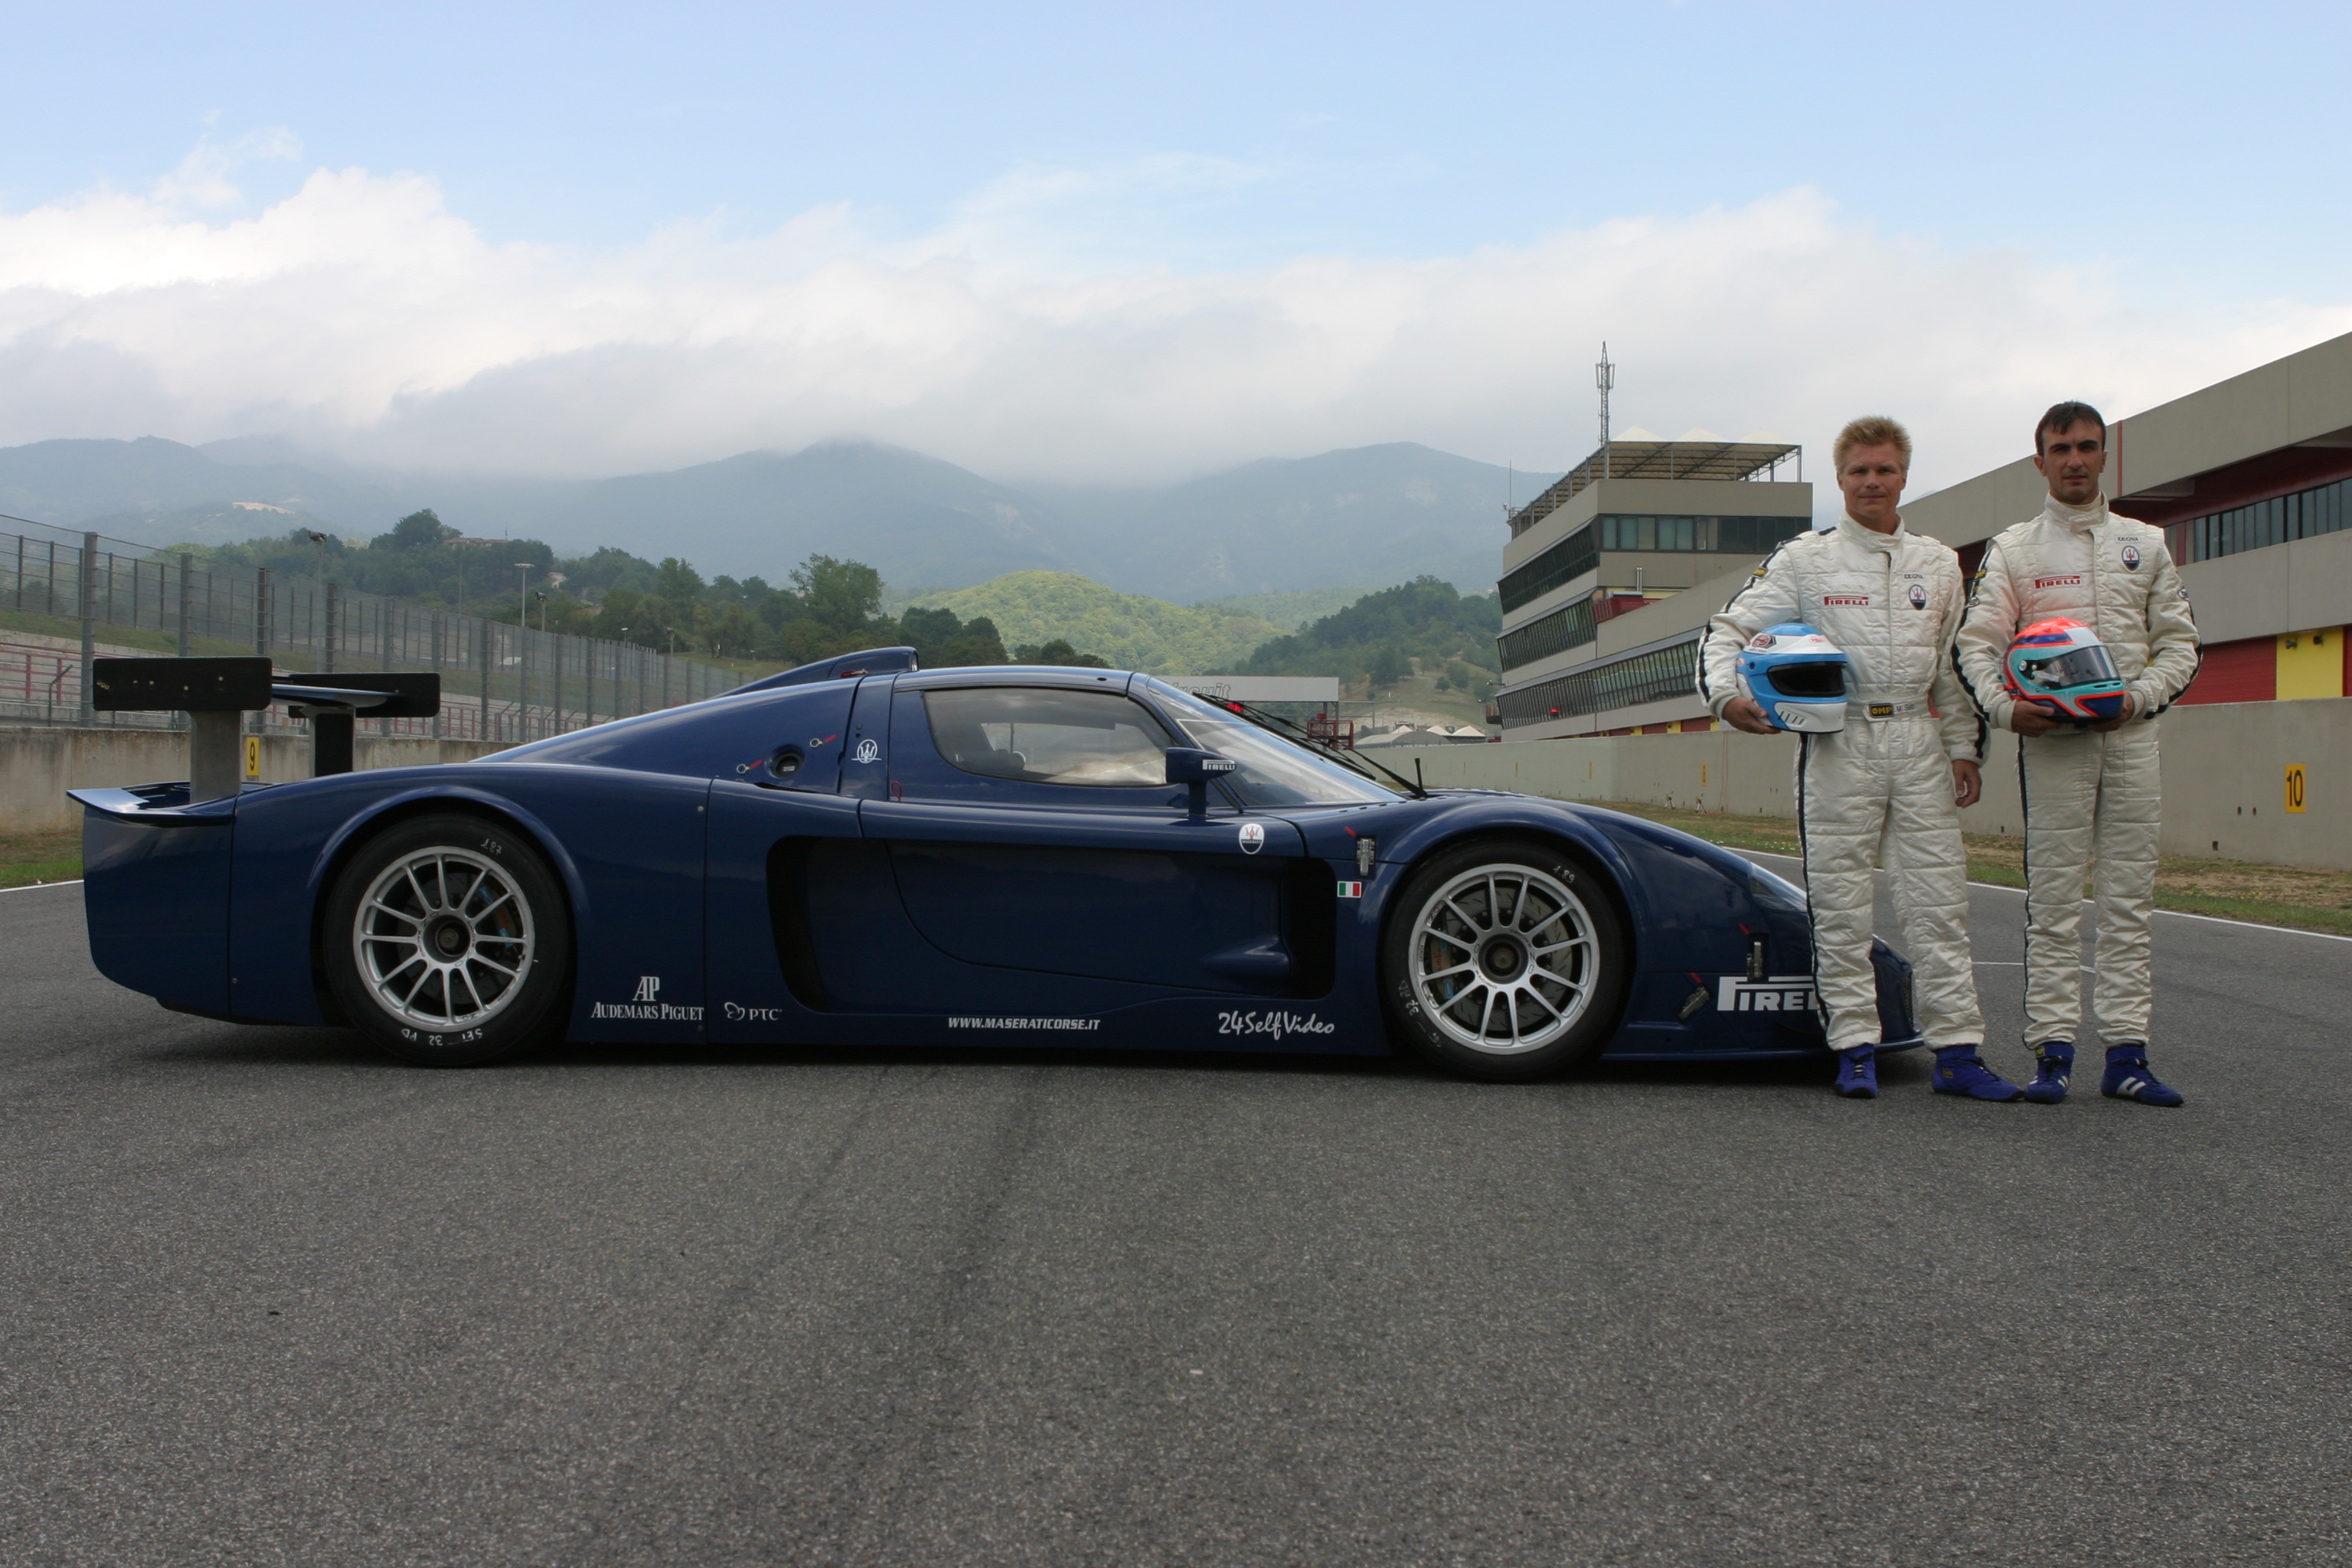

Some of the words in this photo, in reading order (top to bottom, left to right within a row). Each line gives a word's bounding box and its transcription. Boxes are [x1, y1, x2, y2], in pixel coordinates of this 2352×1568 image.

[2035, 575, 2081, 589] PIRELLI
[1824, 594, 1870, 606] PIRELLI
[1872, 706, 1893, 715] OMP
[250, 741, 256, 771] 9
[1202, 759, 1236, 771] PIRELLI
[2286, 769, 2303, 807] 10
[632, 975, 660, 1001] AP
[1717, 975, 1818, 1011] PIREL
[590, 1001, 659, 1019] AUDEMARS
[660, 1003, 704, 1021] PIGUET
[749, 1008, 779, 1021] PTC
[948, 1017, 1101, 1031] WWW.MASERATICORSE.IT
